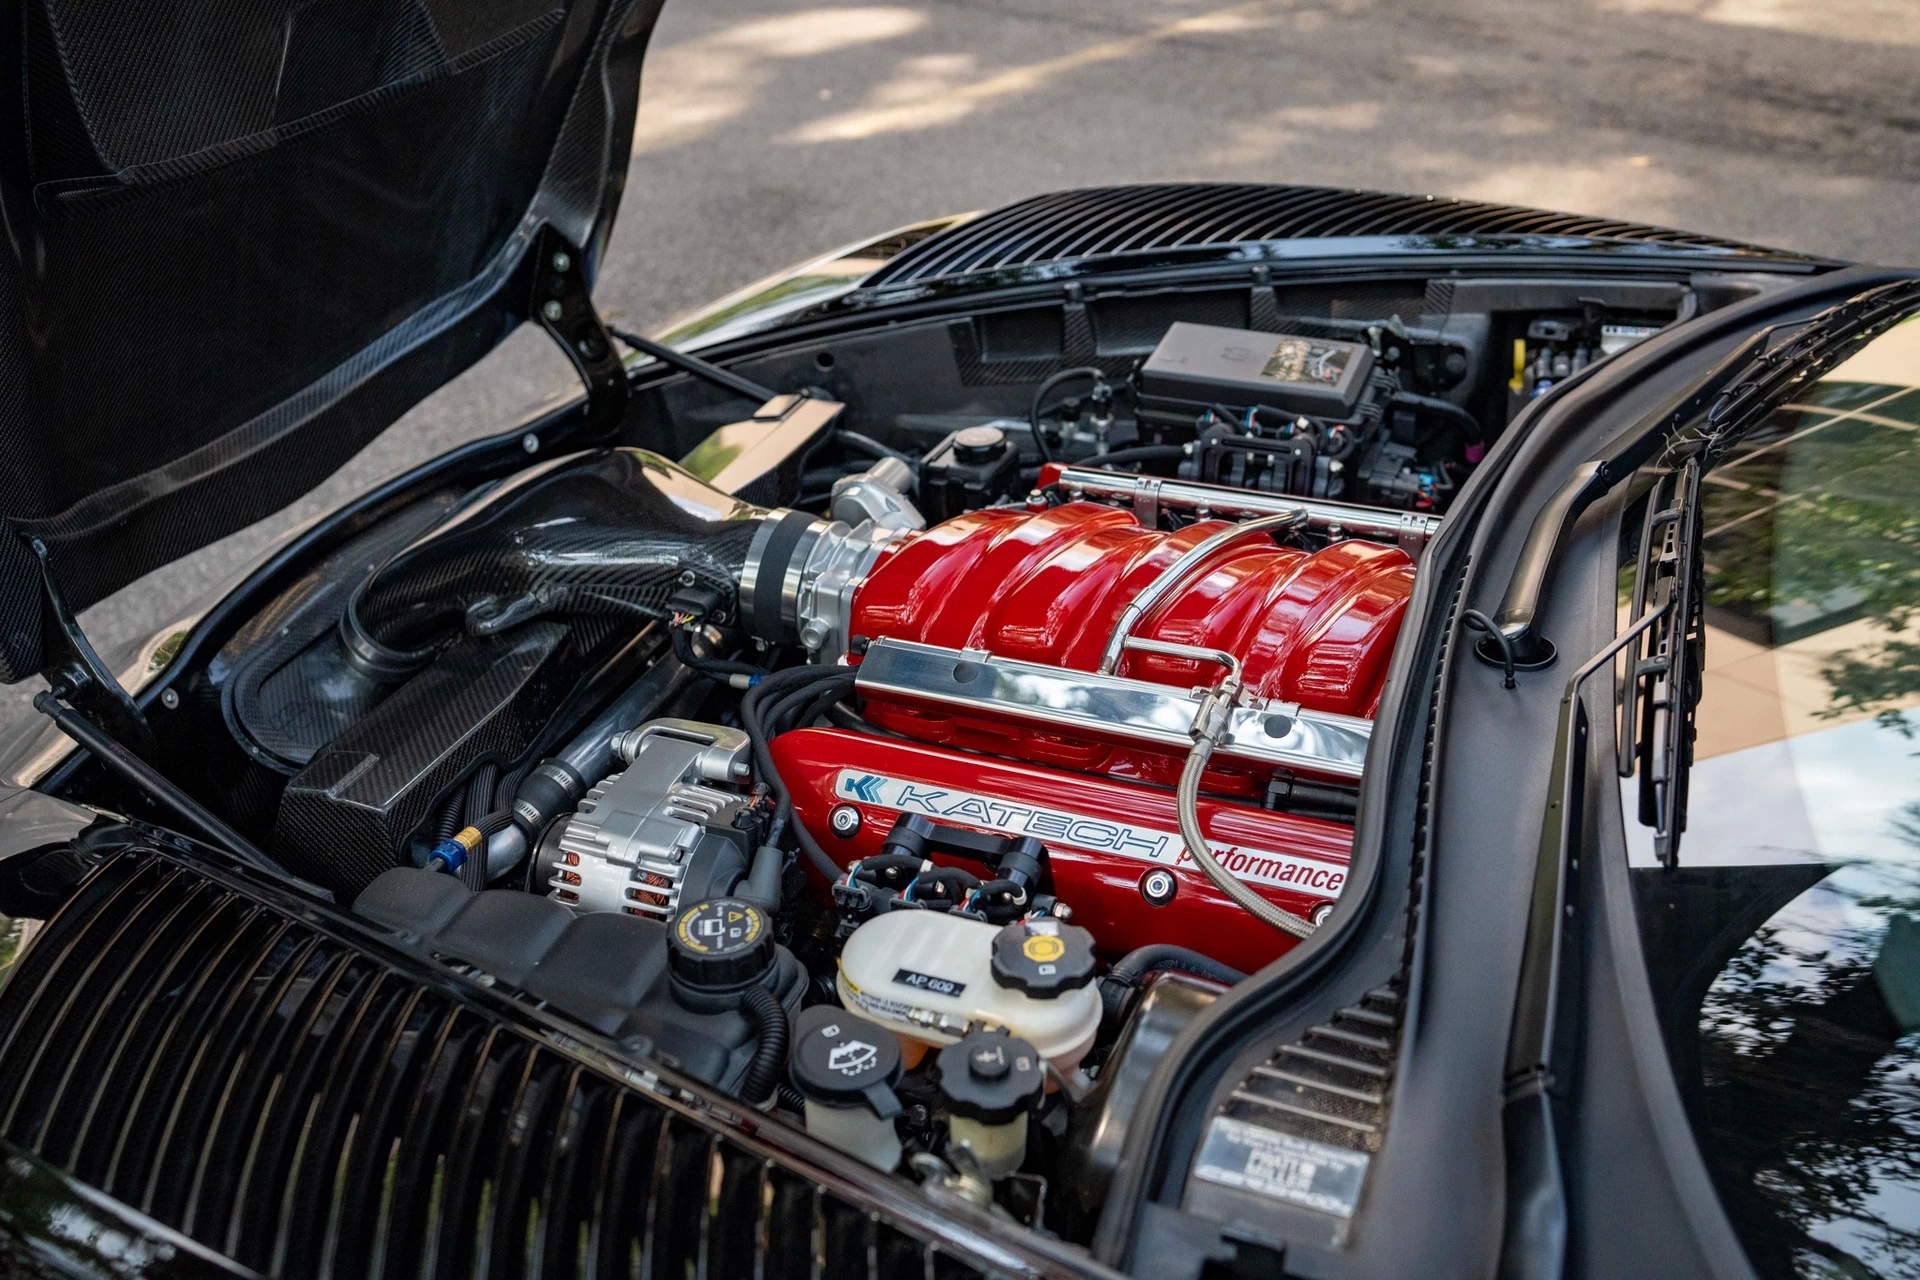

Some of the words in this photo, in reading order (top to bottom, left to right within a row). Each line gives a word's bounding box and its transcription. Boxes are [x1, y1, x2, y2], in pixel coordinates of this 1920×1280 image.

[896, 785, 1169, 858] KATECH
[1175, 845, 1345, 891] prformance
[905, 973, 928, 986] AP
[927, 979, 955, 993] 600
